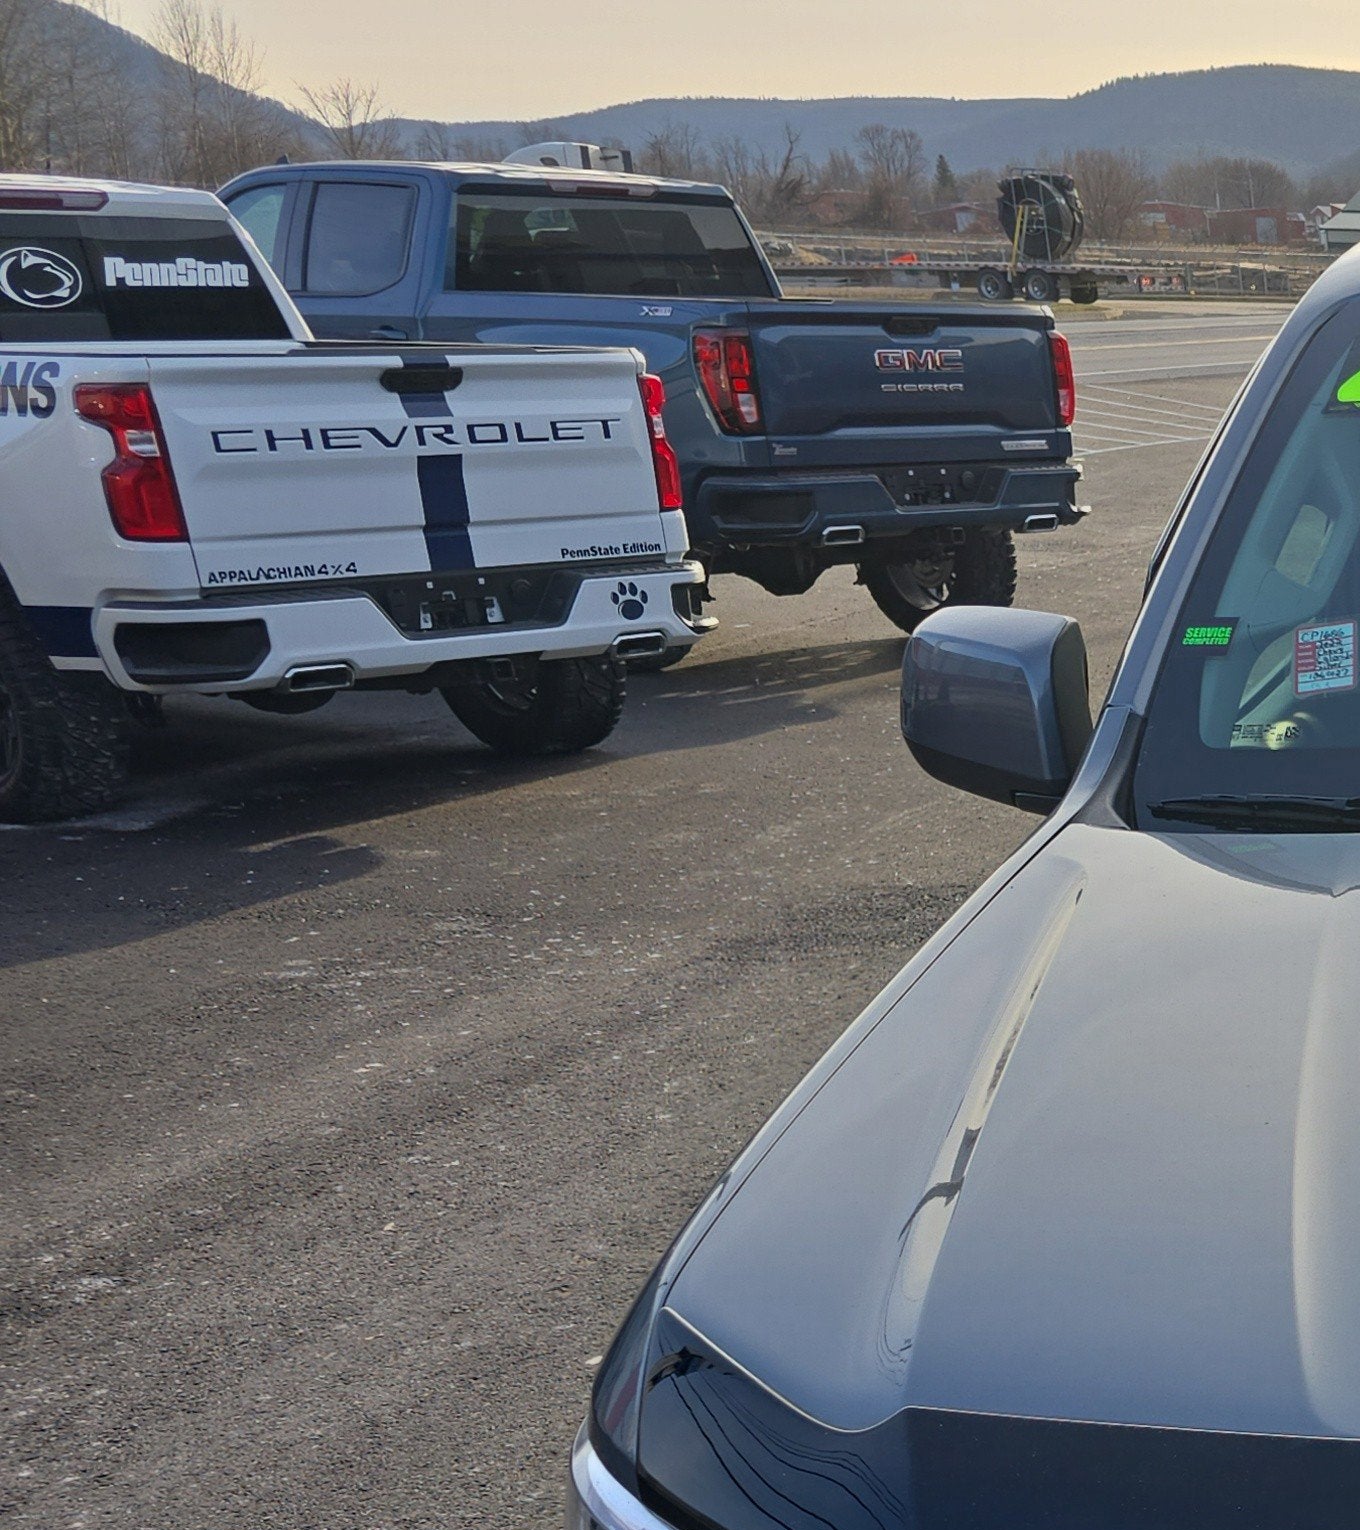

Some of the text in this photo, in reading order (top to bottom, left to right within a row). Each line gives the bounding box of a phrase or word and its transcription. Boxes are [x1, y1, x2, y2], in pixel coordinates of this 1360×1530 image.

[104, 257, 249, 287] PennState
[874, 349, 964, 373] GMC
[211, 418, 621, 454] CHEVROLET
[561, 542, 661, 559] PennState Edition
[1182, 637, 1229, 645] COMPLETED
[1186, 627, 1232, 638] SERVICE
